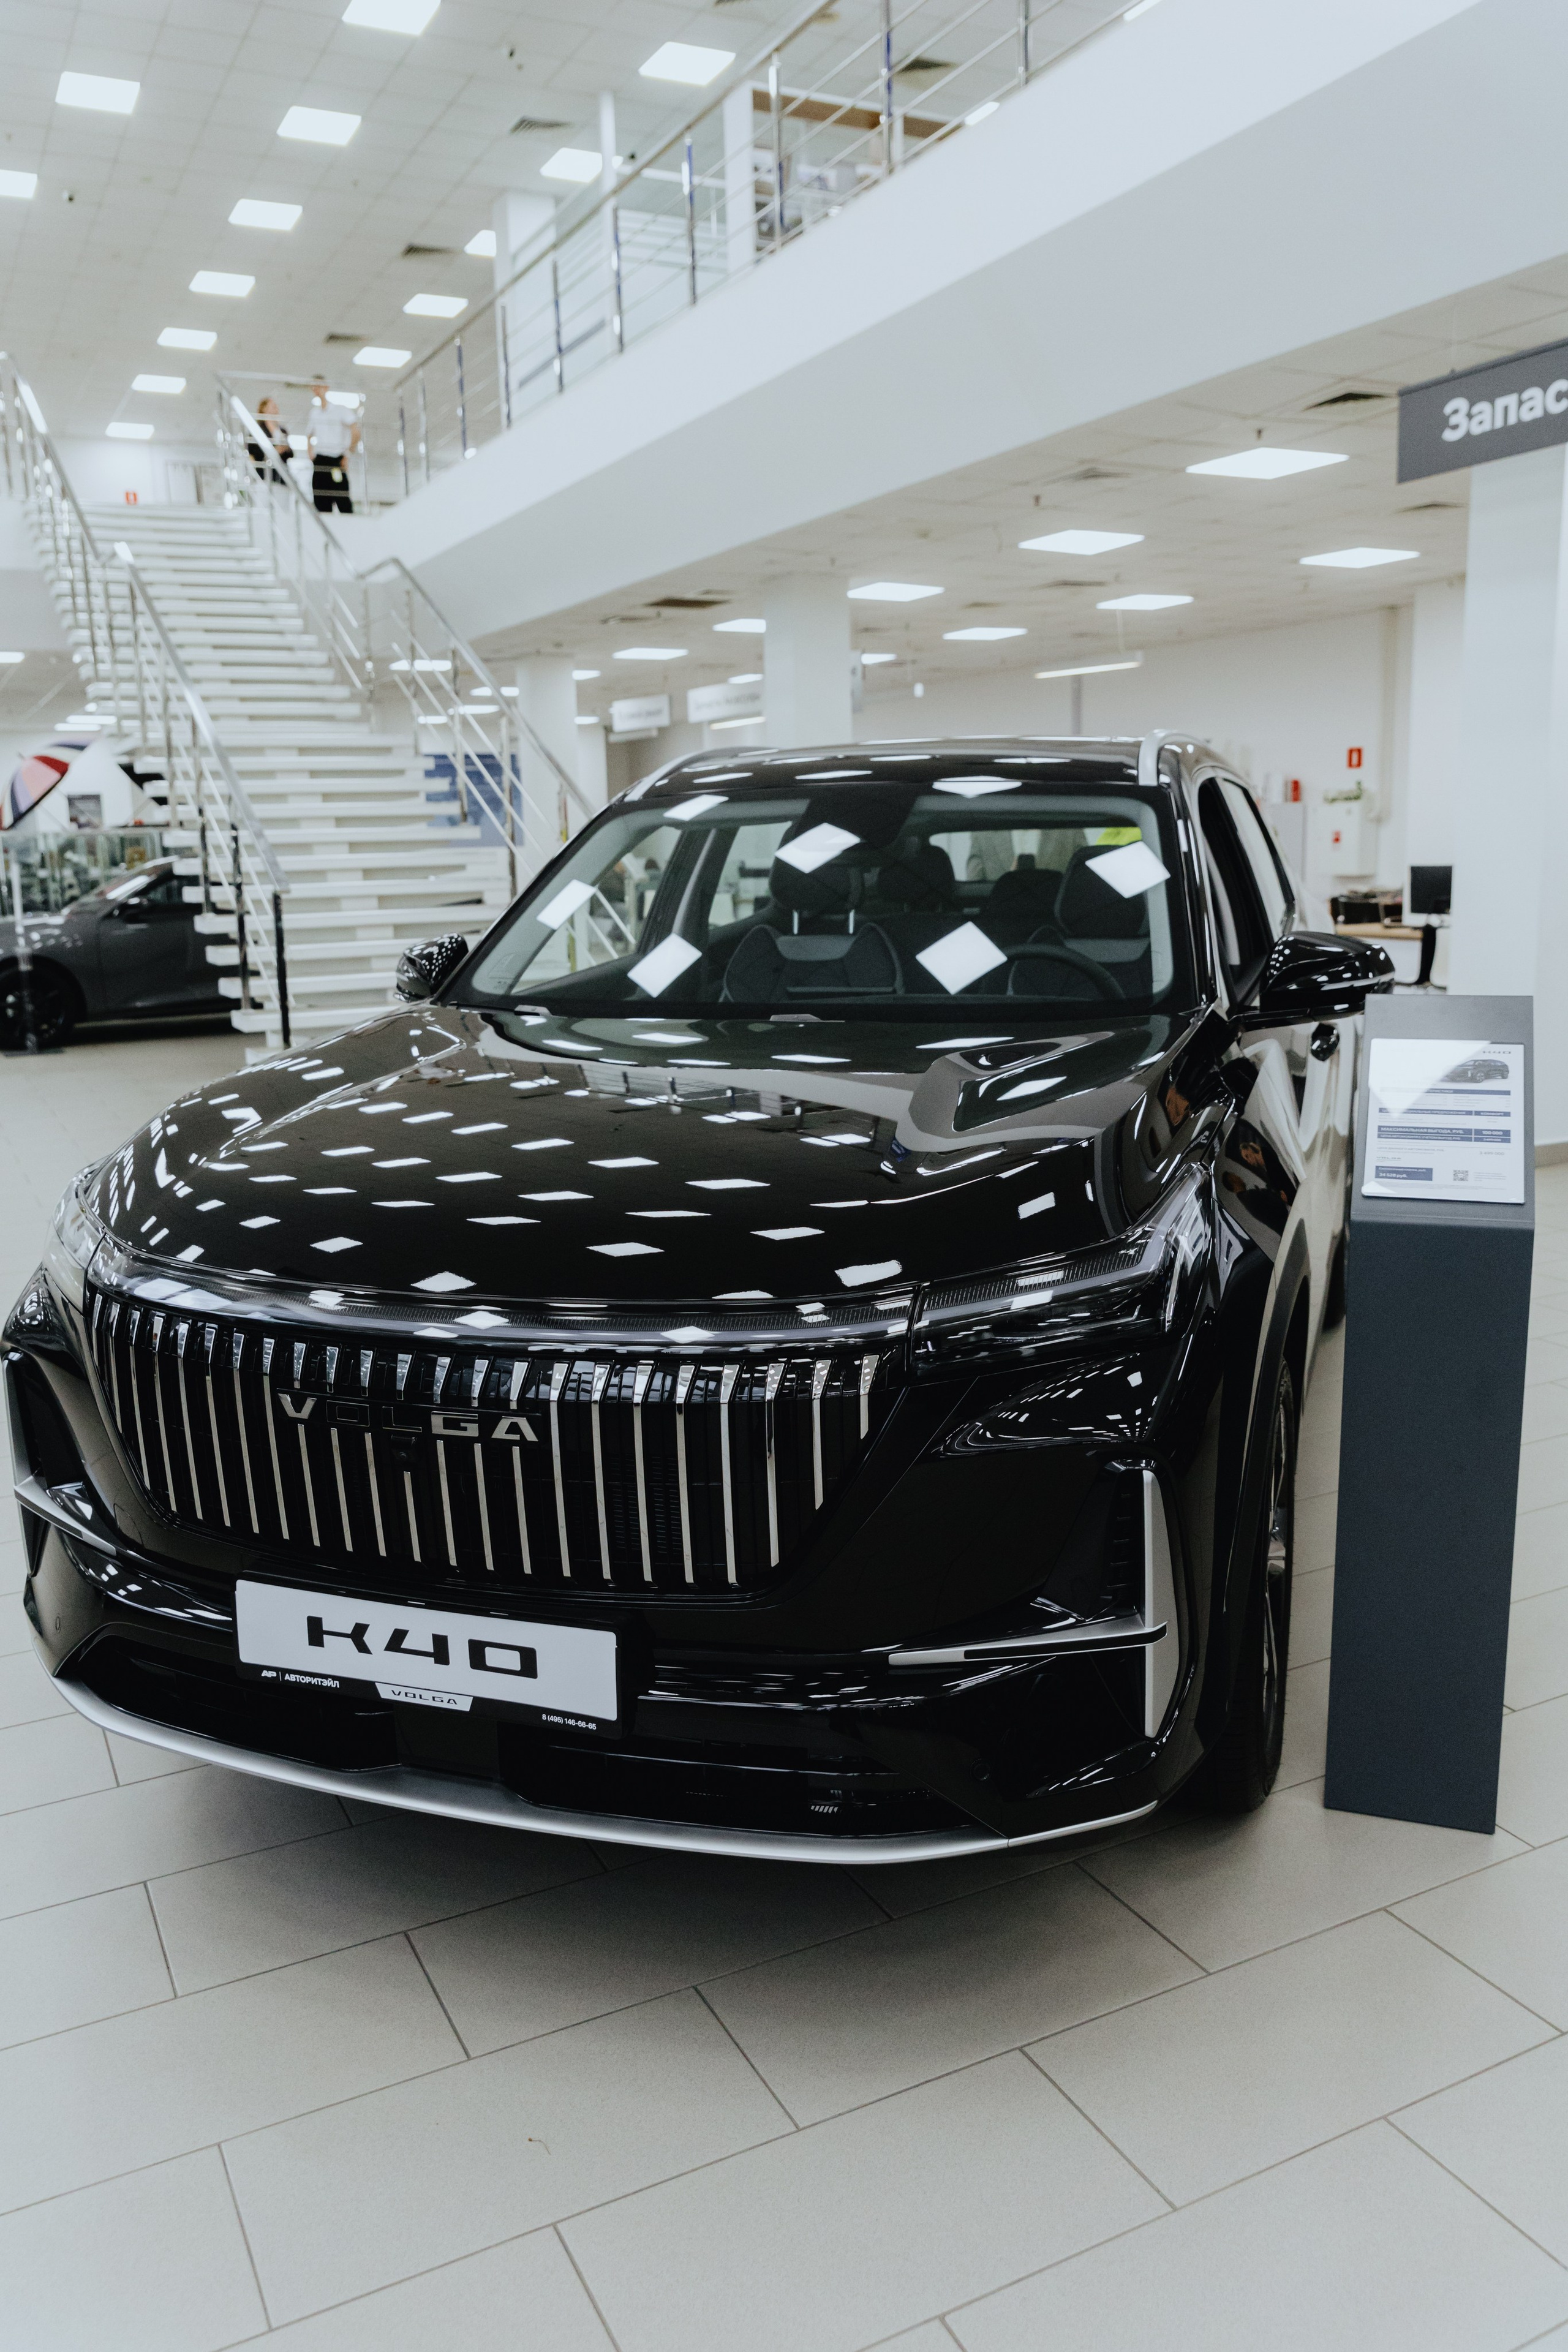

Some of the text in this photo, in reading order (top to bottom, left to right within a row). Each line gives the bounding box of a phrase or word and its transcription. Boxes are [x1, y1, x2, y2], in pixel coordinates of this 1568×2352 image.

[1441, 379, 1568, 442] Запас
[277, 1393, 538, 1442] VOLGA
[306, 1615, 538, 1679] K40
[284, 1673, 340, 1688] АВТОРИТЭЙЛ
[391, 1689, 458, 1705] VOLGA
[548, 1715, 564, 1724] (495)
[564, 1718, 597, 1730] 146-66-65
